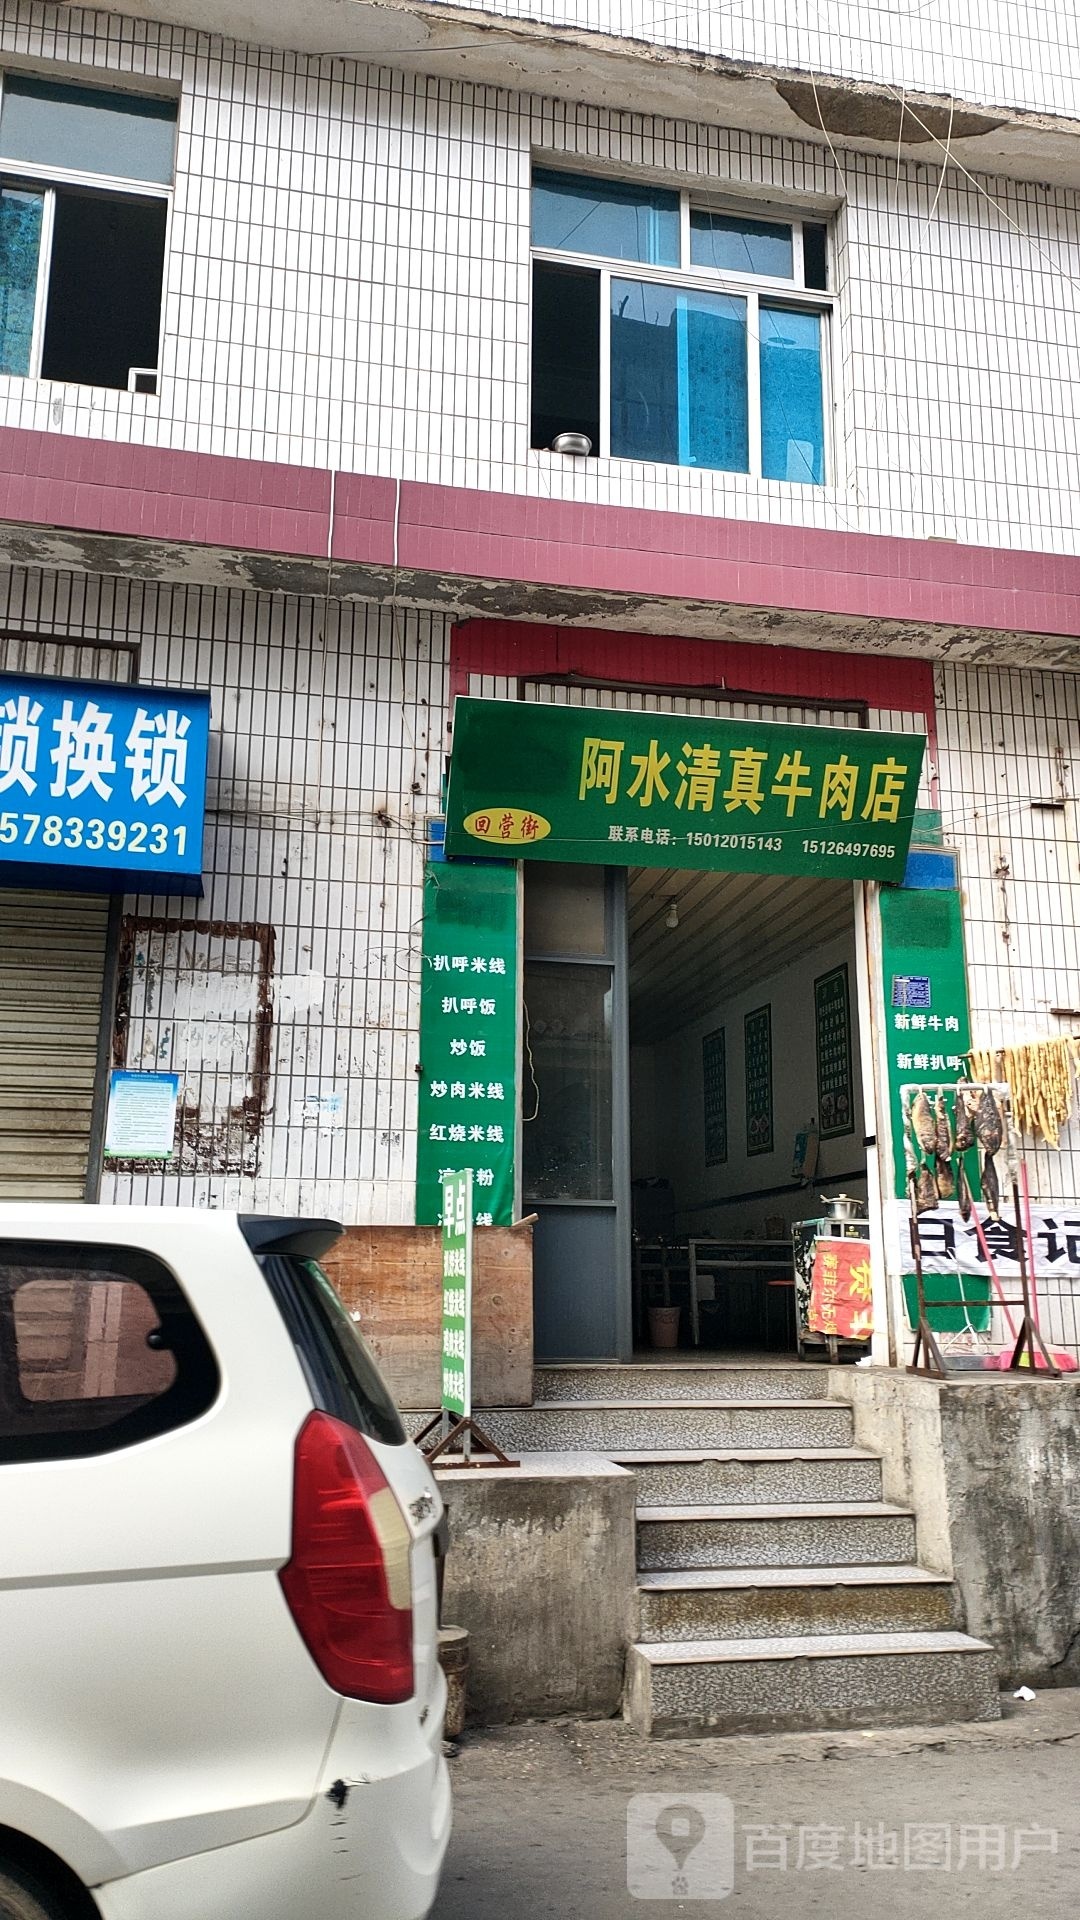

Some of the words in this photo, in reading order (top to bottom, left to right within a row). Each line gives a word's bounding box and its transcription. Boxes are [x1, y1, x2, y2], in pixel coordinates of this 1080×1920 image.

[579, 737, 908, 823] 阿水清真牛肉店
[0, 812, 187, 856] 578339231
[474, 815, 540, 840] 回营街
[608, 825, 676, 847] 联系电话：
[686, 832, 783, 852] 15012015143
[802, 840, 896, 859] 15126497695
[433, 954, 506, 975] 扒呼米线
[441, 996, 497, 1015] 扒呼饭
[894, 1013, 959, 1032] 新鲜牛肉
[449, 1038, 487, 1057] 炒饭
[896, 1053, 962, 1072] 新鲜扒呼
[429, 1080, 505, 1101] 炒肉米线
[428, 1123, 505, 1144] 红烧米线
[443, 1178, 466, 1240] 早点
